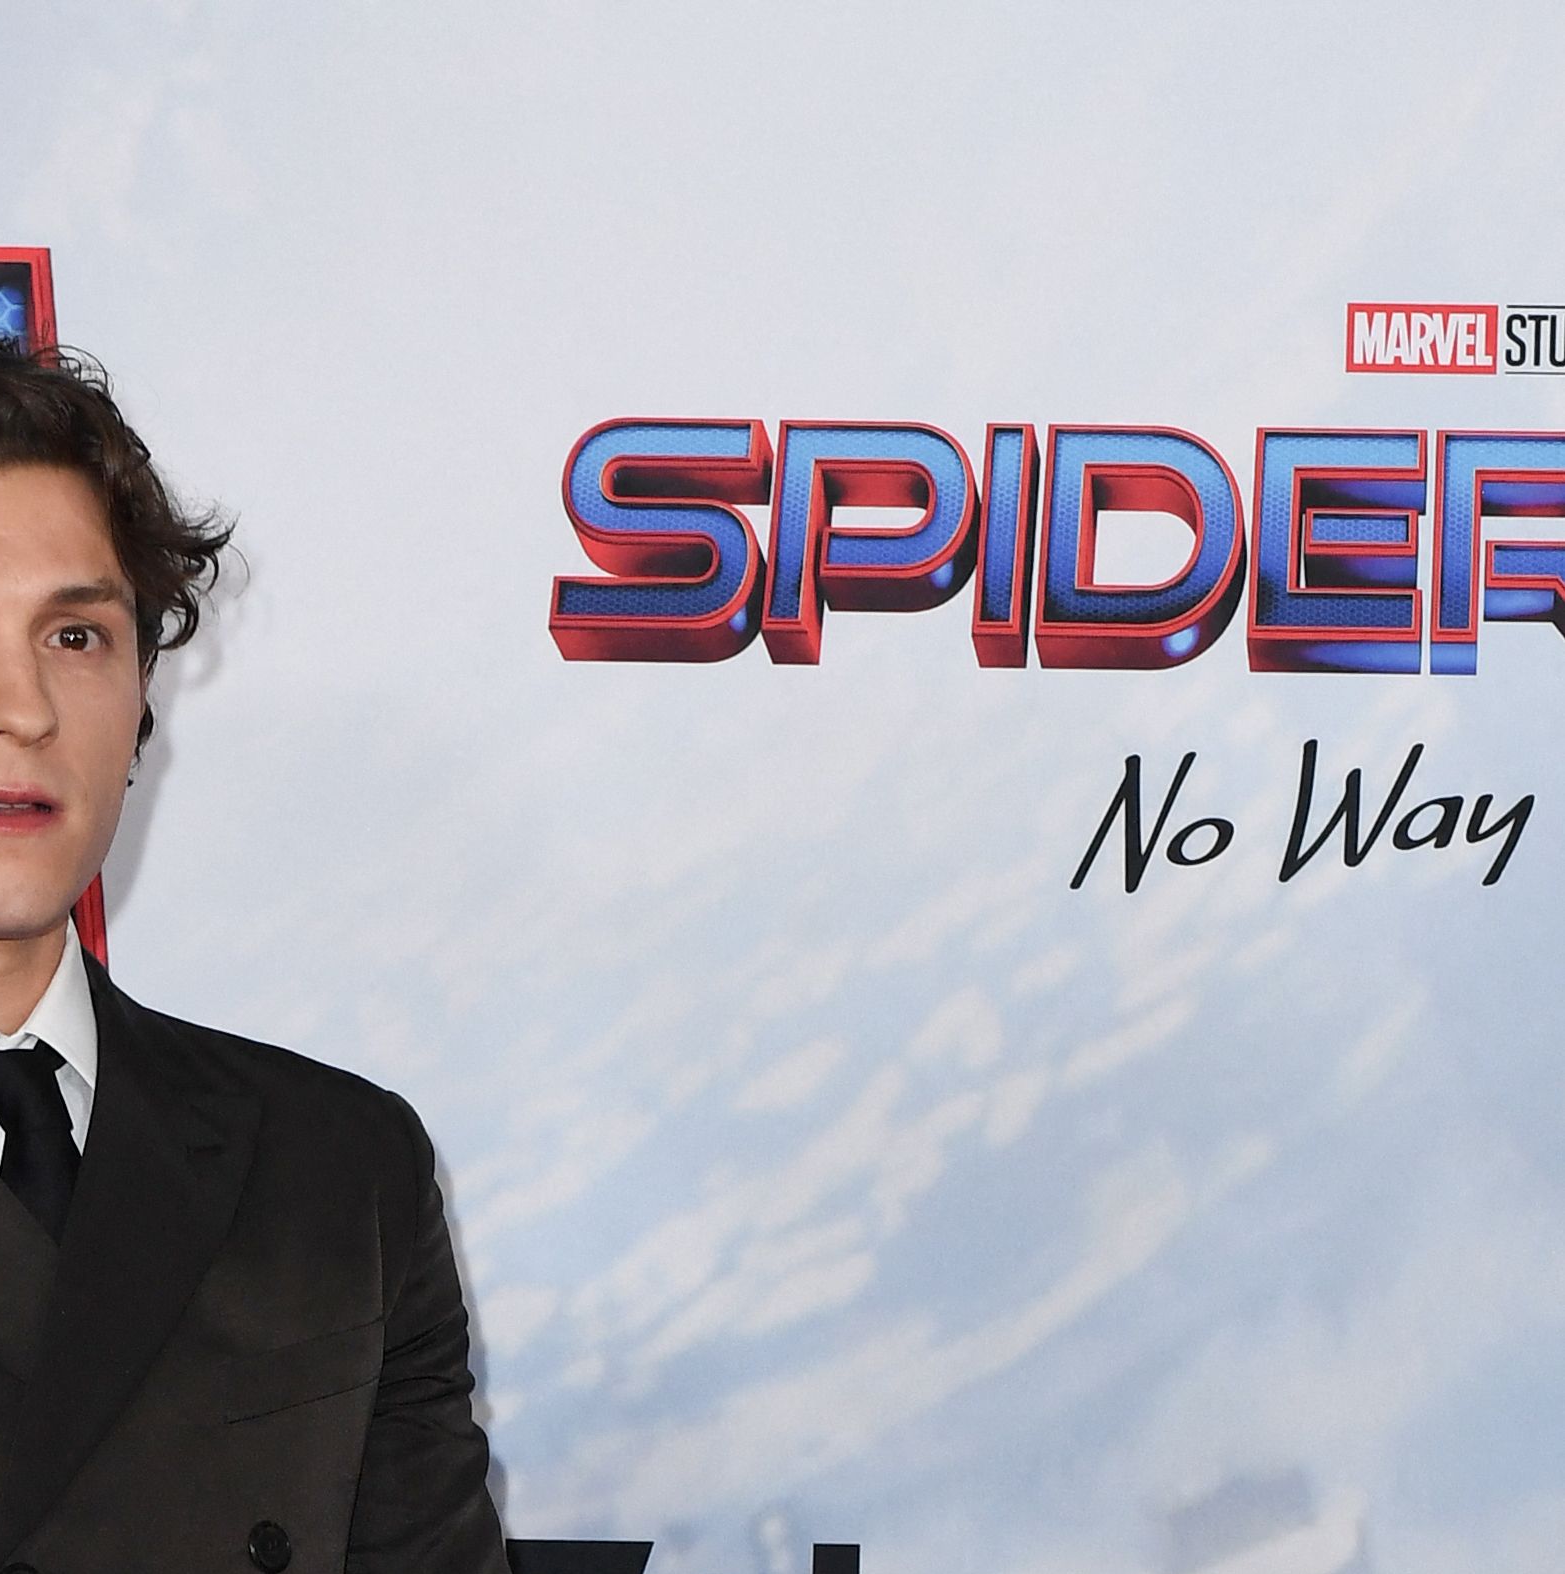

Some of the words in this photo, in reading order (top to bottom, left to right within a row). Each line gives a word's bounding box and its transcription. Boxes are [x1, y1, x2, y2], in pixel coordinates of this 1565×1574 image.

[1353, 311, 1493, 367] MARVEL
[1069, 750, 1235, 894] No
[1279, 738, 1536, 886] Way
